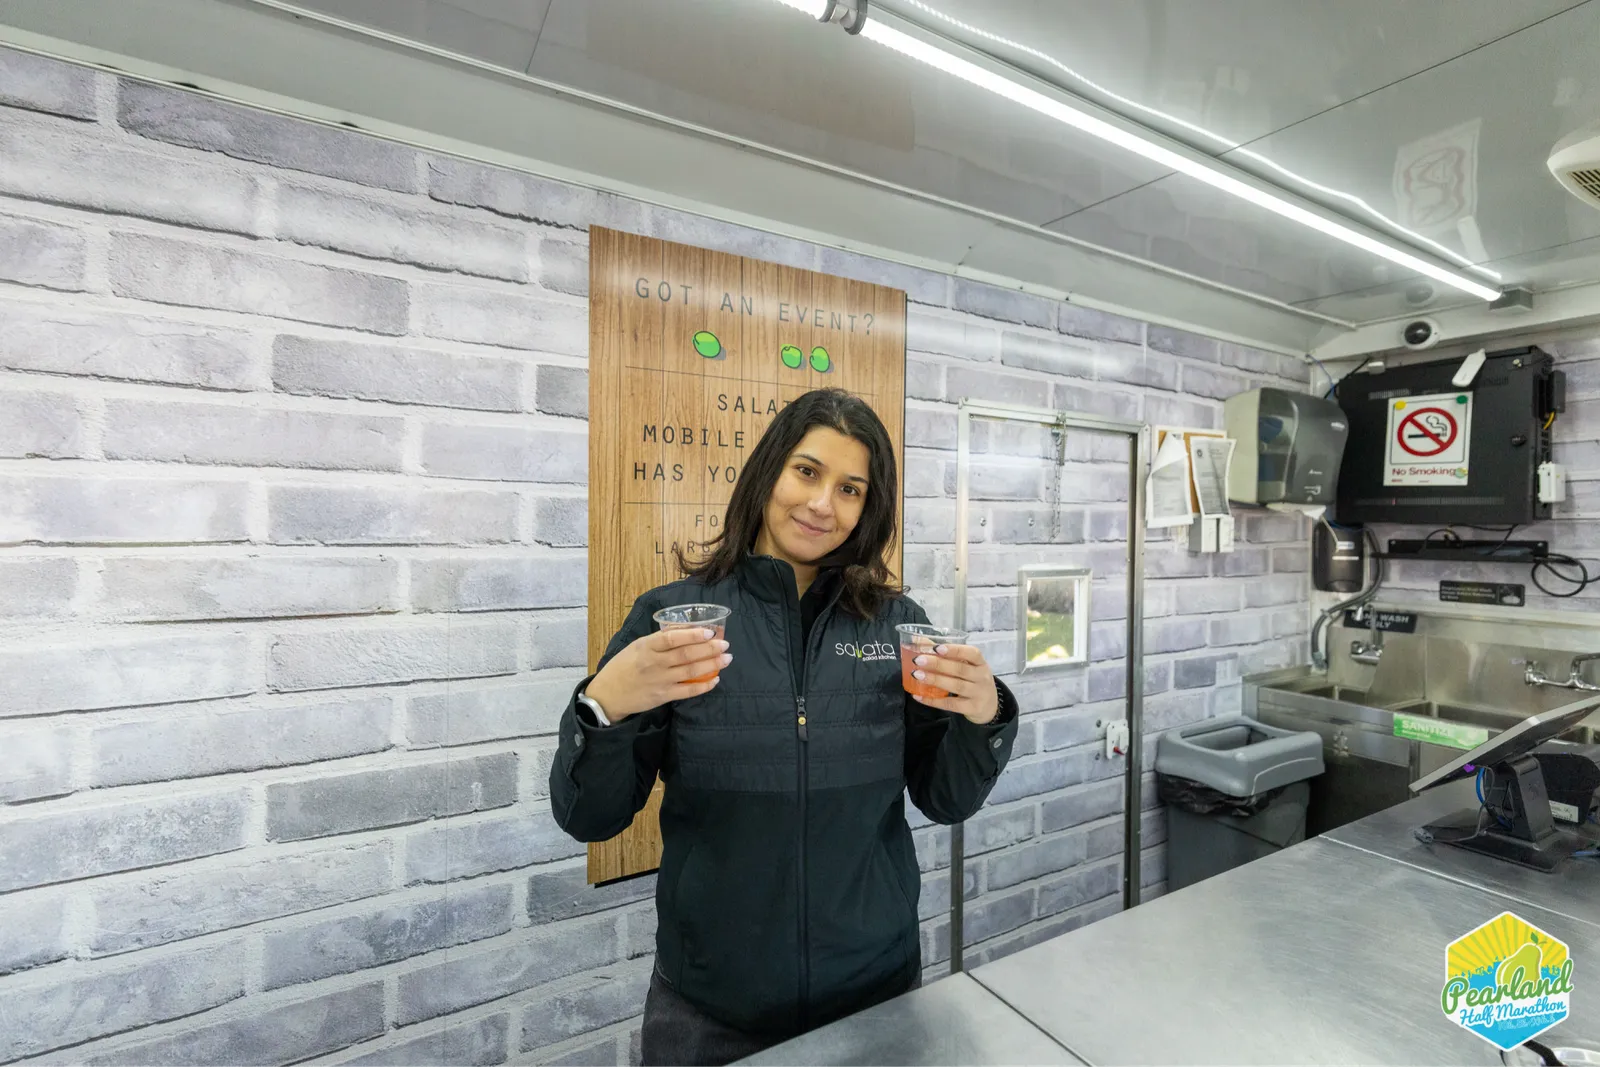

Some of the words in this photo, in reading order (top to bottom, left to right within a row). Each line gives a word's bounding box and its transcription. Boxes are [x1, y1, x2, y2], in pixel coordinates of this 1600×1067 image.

[635, 277, 693, 305] GOT
[720, 292, 753, 316] AN
[778, 302, 876, 336] EVENT?
[717, 393, 791, 415] SALA
[643, 424, 745, 448] MOBILE
[633, 462, 684, 482] HAS
[708, 465, 736, 484] YO
[1391, 467, 1407, 476] No
[1408, 467, 1456, 478] Smoking
[695, 514, 719, 528] FO
[655, 541, 711, 554] LARG
[1380, 613, 1410, 624] WASH
[835, 640, 896, 658] salata
[1402, 719, 1454, 737] SANITIZ
